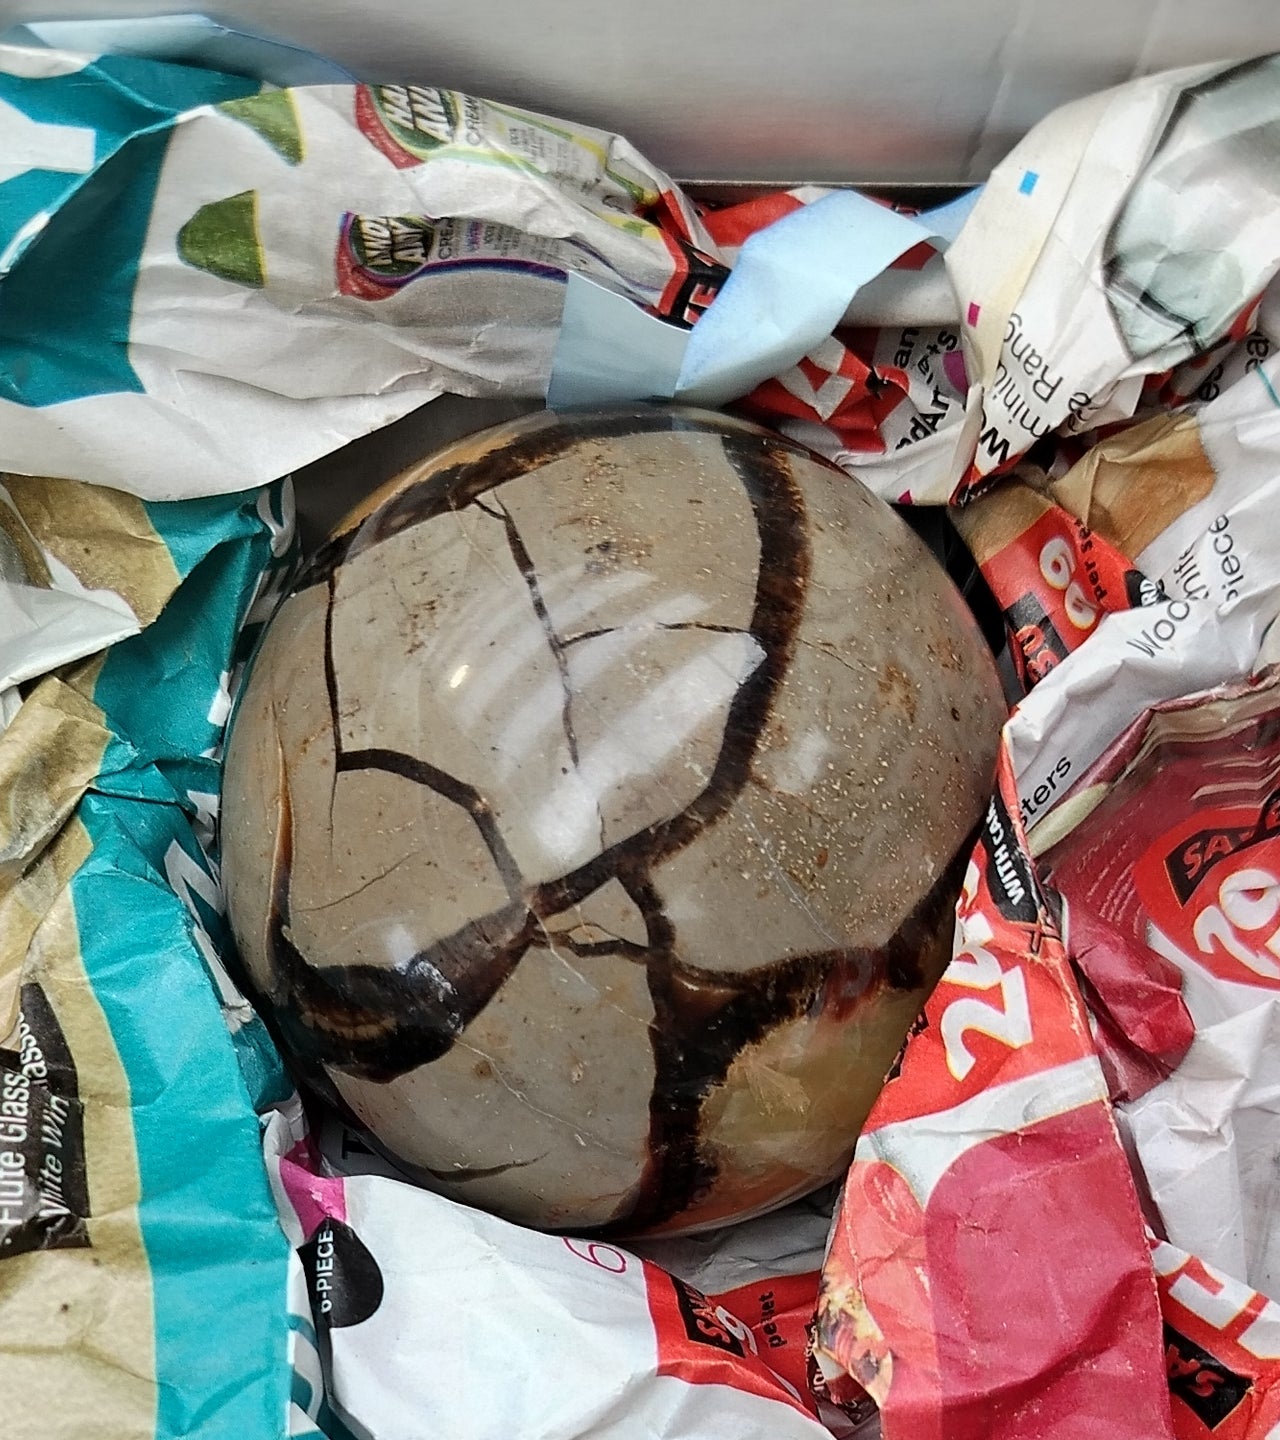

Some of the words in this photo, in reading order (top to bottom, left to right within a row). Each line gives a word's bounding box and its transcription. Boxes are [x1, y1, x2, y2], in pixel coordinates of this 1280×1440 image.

[991, 360, 1050, 441] miniu
[1080, 556, 1108, 605] per
[1126, 597, 1193, 659] Woo
[1018, 752, 1074, 830] sters
[993, 841, 1025, 903] WITH
